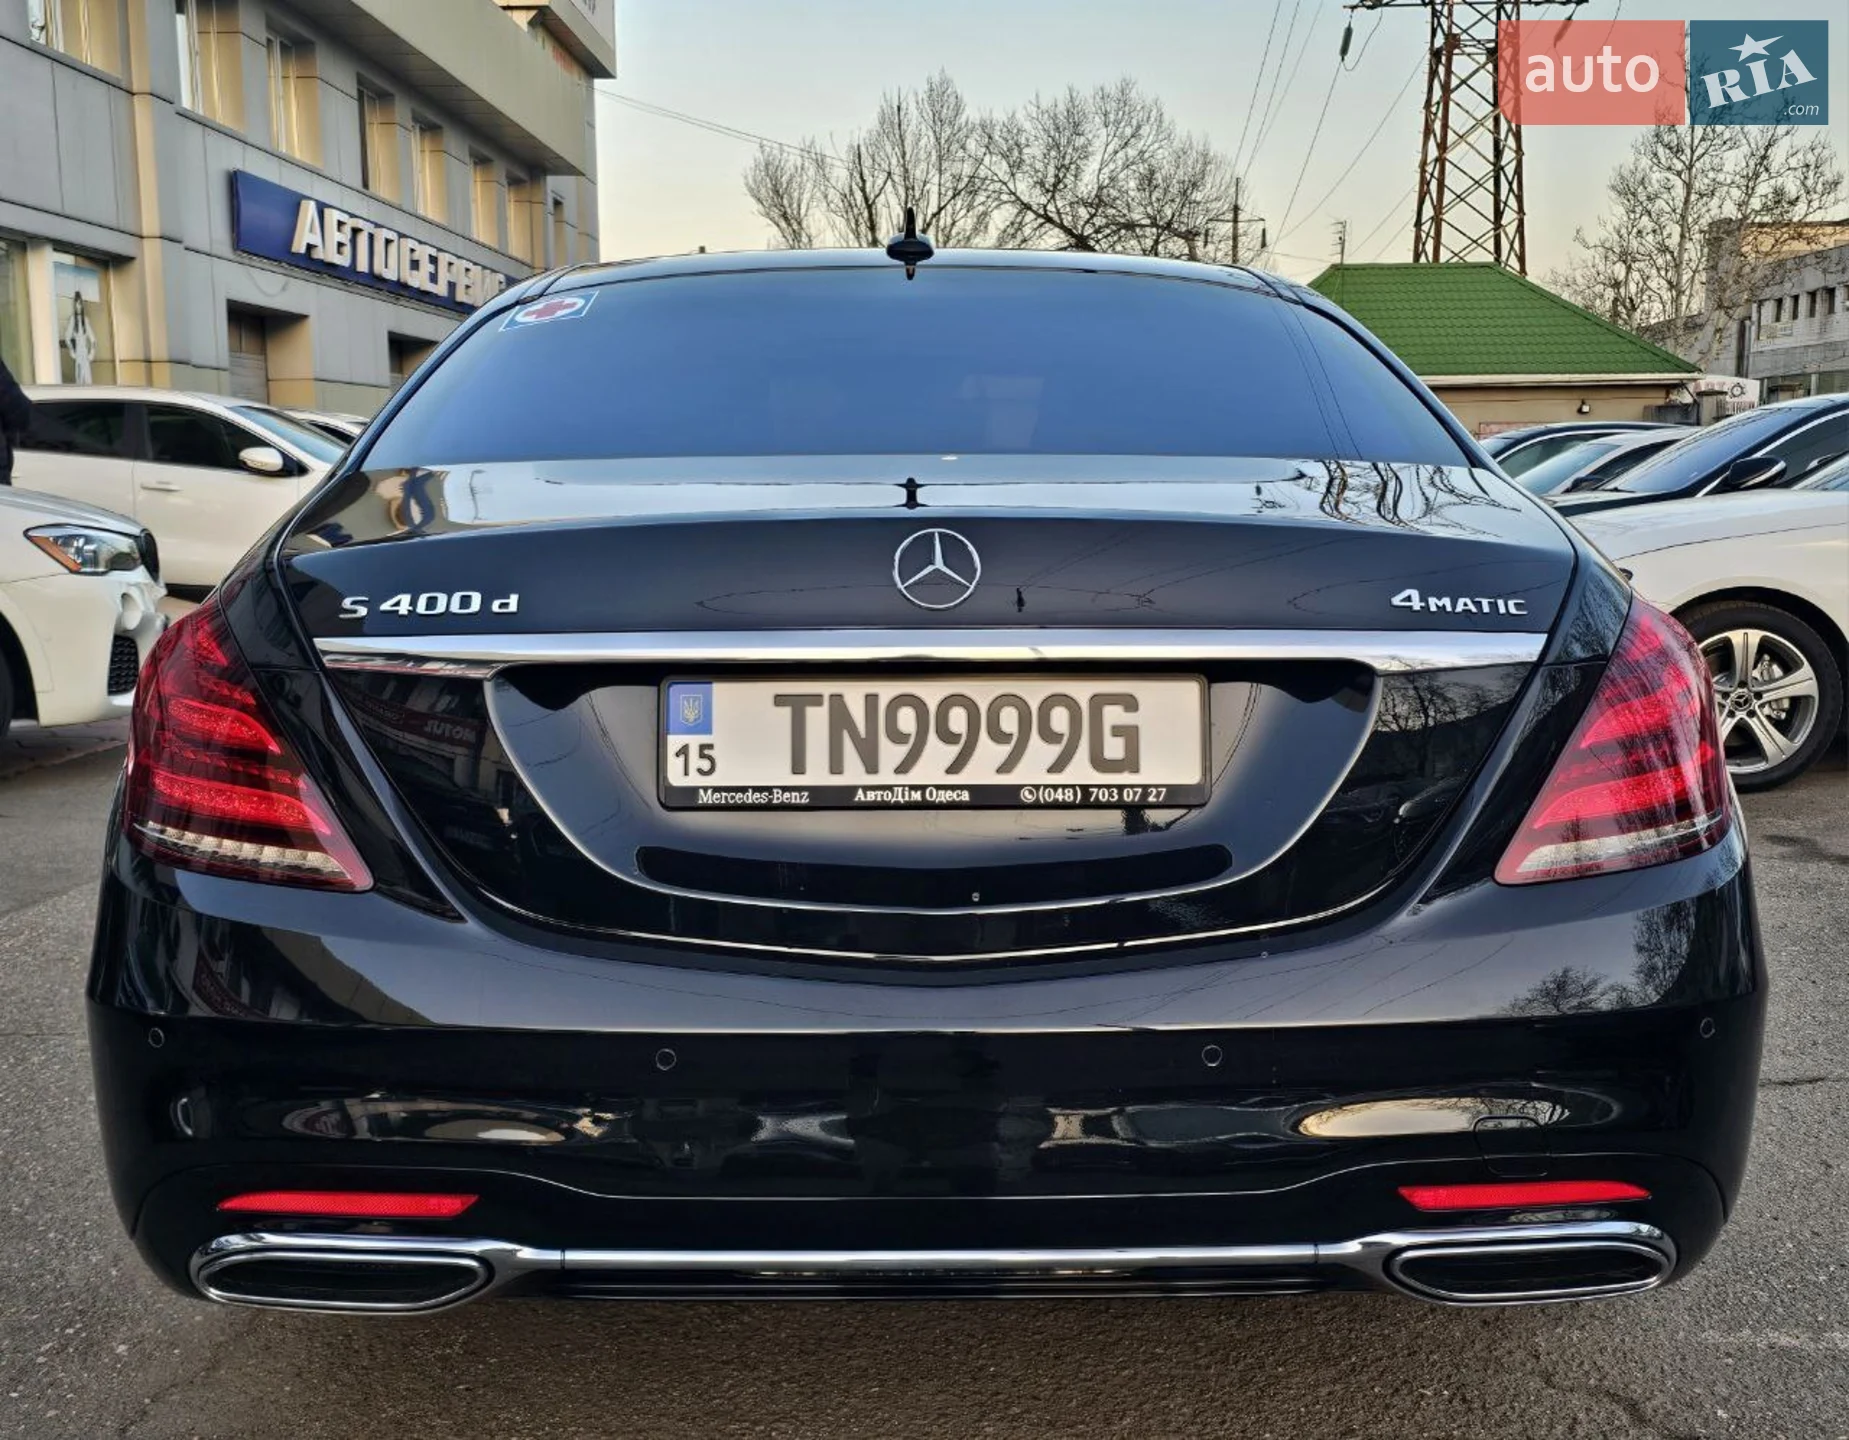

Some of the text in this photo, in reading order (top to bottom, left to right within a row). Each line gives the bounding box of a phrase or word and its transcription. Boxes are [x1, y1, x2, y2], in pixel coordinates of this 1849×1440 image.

[338, 591, 520, 619] S 400 d
[1390, 588, 1529, 616] 4MATIC
[773, 692, 1141, 776] TN9999G
[675, 743, 717, 777] 15
[697, 787, 810, 805] Mercedes-Benz
[854, 786, 971, 805] АвтоДім Одеса
[1038, 785, 1168, 805] (048) 703 07 27
